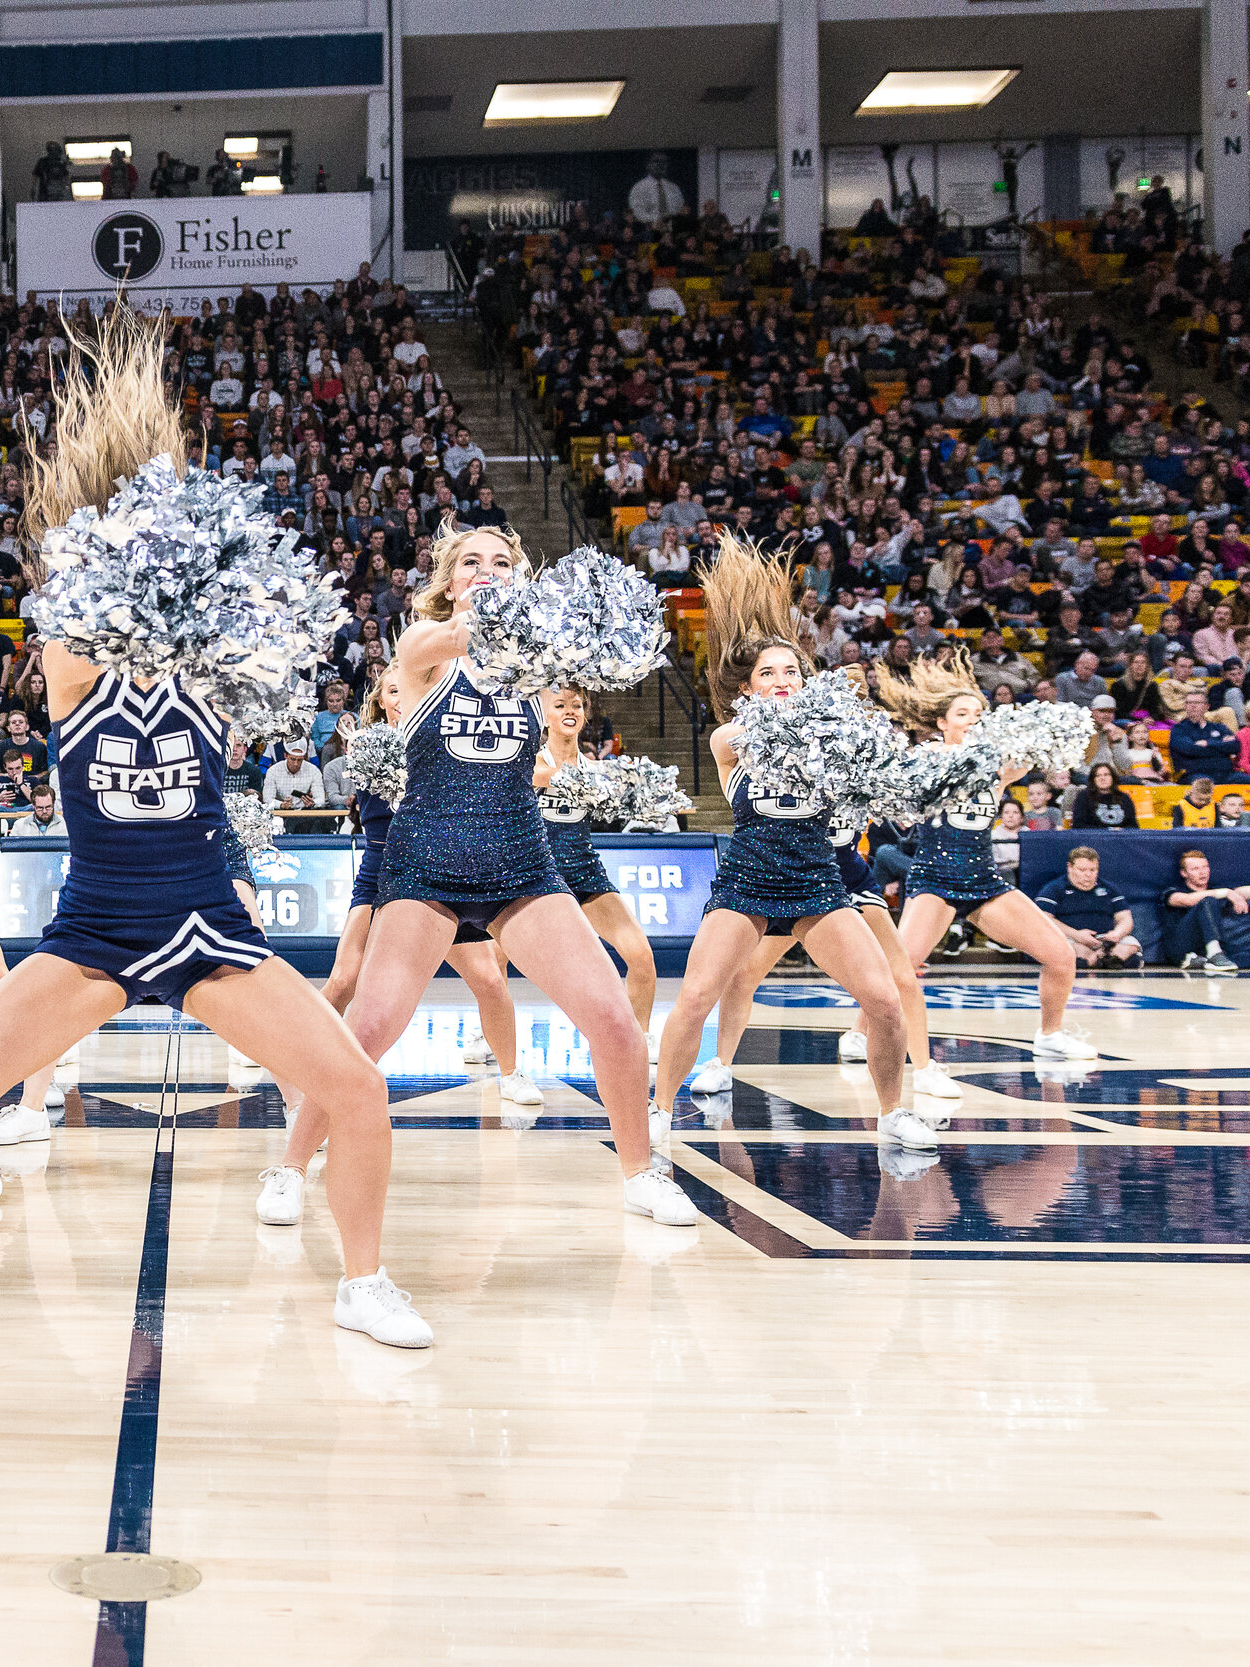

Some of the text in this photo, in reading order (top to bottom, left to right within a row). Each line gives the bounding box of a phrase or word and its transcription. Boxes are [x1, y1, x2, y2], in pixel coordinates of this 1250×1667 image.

[792, 149, 812, 167] M
[1224, 136, 1242, 155] N
[175, 215, 292, 253] Fisher
[113, 227, 144, 268] F
[170, 253, 299, 270] Home Furnishings
[439, 714, 529, 740] STATE
[88, 758, 201, 792] STATE
[618, 864, 684, 889] FOR
[255, 889, 300, 927] 46
